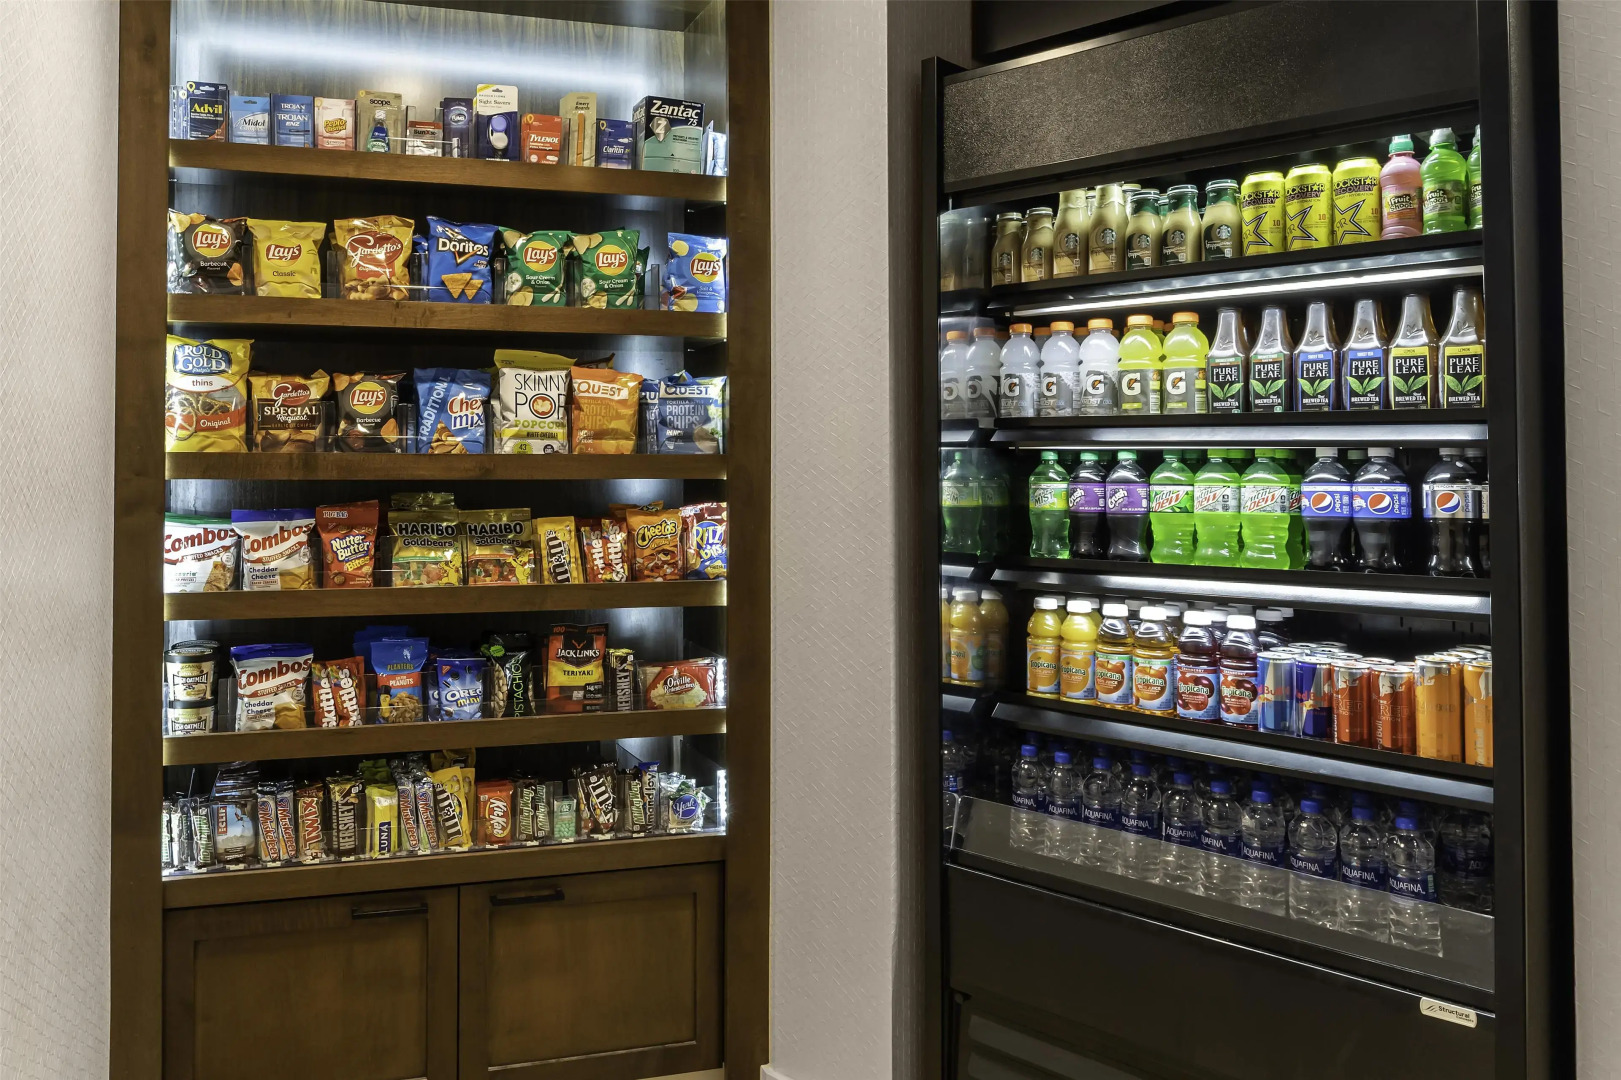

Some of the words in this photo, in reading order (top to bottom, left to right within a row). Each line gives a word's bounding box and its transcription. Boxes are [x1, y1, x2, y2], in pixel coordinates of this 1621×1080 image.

[191, 103, 223, 114] Advil
[369, 98, 391, 107] scope
[650, 100, 700, 119] Zantac
[242, 117, 265, 127] Midol
[688, 118, 698, 126] 75
[530, 134, 559, 144] TYLENOL
[603, 146, 624, 154] Claritin
[1390, 194, 1411, 205] Fruit
[1426, 188, 1444, 201] Fruit
[1390, 202, 1414, 212] Shoot
[268, 243, 300, 261] Lay's
[345, 234, 402, 268] Gardetto's
[438, 237, 489, 256] Doritos
[597, 253, 626, 269] Lay's
[693, 258, 721, 276] Lay's
[184, 344, 225, 360] ROLD
[175, 355, 225, 371] GOLD
[1255, 362, 1280, 372] PURE
[1304, 361, 1329, 370] PURE
[1352, 360, 1377, 369] PURE
[1396, 357, 1424, 367] PURE
[1450, 356, 1479, 366] PURE
[1213, 366, 1237, 375] PURE
[192, 379, 213, 387] thins
[577, 381, 623, 397] QUEST
[1004, 377, 1020, 395] G
[1042, 376, 1057, 395] G
[1089, 375, 1104, 394] G
[1121, 372, 1141, 396] G
[1166, 371, 1186, 395] G
[272, 383, 310, 407] Gardetto's
[351, 388, 385, 407] Lay's
[664, 385, 710, 396] QUEST
[264, 406, 319, 416] SPECIAL
[448, 394, 482, 414] Chex
[667, 404, 705, 416] PROTEIN
[200, 416, 231, 428] Original
[452, 411, 484, 430] mix
[667, 415, 700, 429] CHIPS
[1034, 492, 1055, 504] MIST
[1108, 488, 1129, 510] Crush
[398, 522, 456, 537] HARIBO
[467, 521, 523, 537] HARIBO
[635, 519, 677, 549] Cheetos
[243, 522, 314, 556] Combos
[331, 534, 365, 552] Nutter
[403, 538, 454, 548] Goldbears
[475, 537, 520, 547] Goldbears
[337, 541, 371, 563] Butter
[608, 523, 627, 582] Skittles
[249, 566, 279, 574] Cheddar
[345, 555, 370, 572] Bites
[556, 648, 577, 658] JACK
[387, 663, 414, 671] PLANTERS
[1030, 660, 1057, 670] Tropicana
[1061, 664, 1086, 676] Tropicana
[238, 657, 312, 690] Combos
[563, 669, 594, 677] TERIYAKI
[390, 678, 414, 687] PEANUTS
[668, 675, 691, 687] Orville
[1136, 674, 1165, 687] Tropicana
[1179, 682, 1210, 695] Tropicana
[1221, 686, 1253, 700] Tropicana
[339, 668, 363, 727] Skittles
[456, 697, 480, 708] mini
[247, 707, 272, 715] Cheese
[1380, 704, 1410, 718] RED
[185, 719, 206, 730] OATMEAL
[675, 801, 696, 817] York
[1048, 804, 1078, 816] AQUAFINA
[1084, 808, 1115, 822] AQUAFINA
[302, 799, 322, 850] TWIX
[339, 797, 356, 853] HERSHEY'S
[401, 800, 419, 851] Musketeers
[419, 802, 439, 850] Musketeers
[259, 811, 280, 861] Musketeers
[278, 807, 297, 858] Musketeers
[1166, 825, 1198, 840] AQUAFINA
[380, 825, 389, 856] LUNA
[1243, 846, 1276, 862] AQUAFINA
[1390, 877, 1426, 895] AQUAFINA
[1438, 1005, 1470, 1019] Structural
